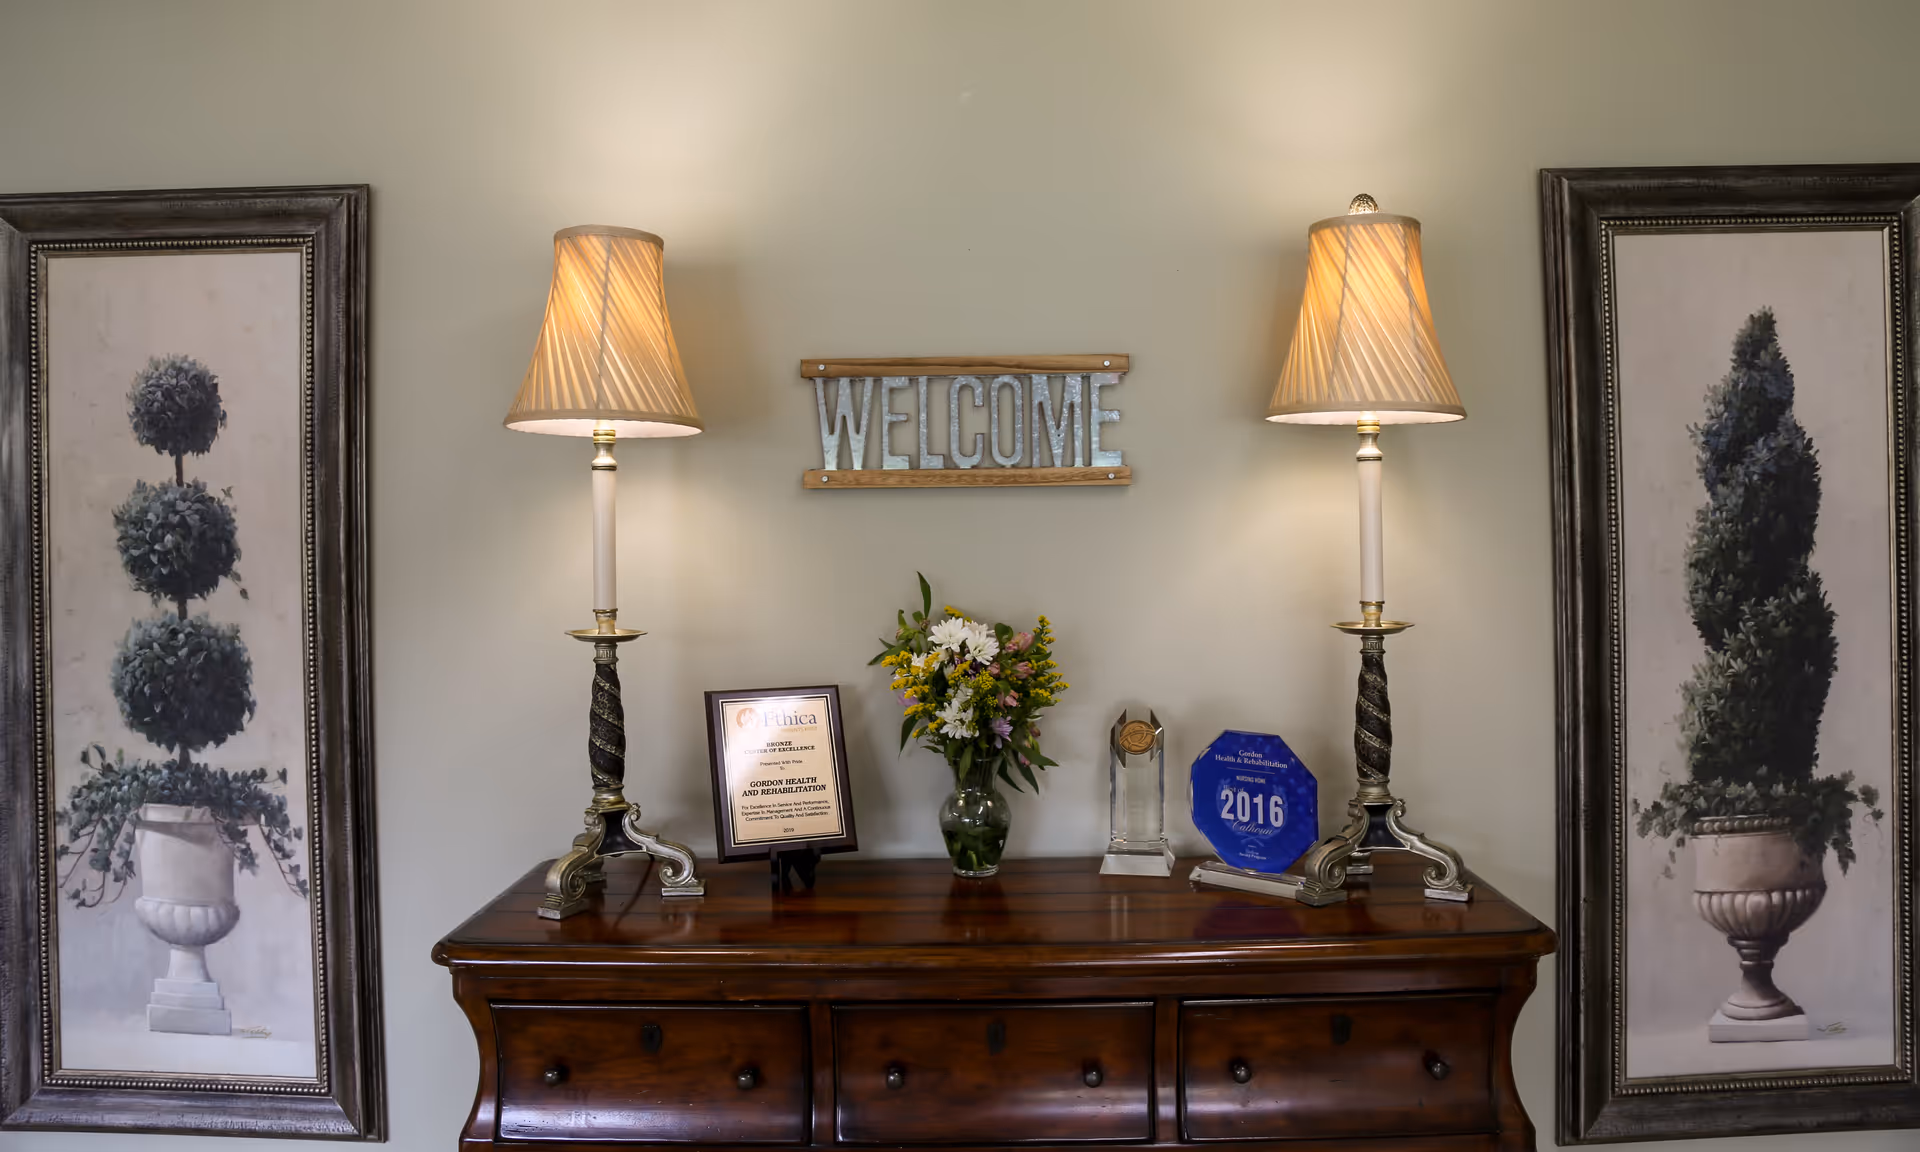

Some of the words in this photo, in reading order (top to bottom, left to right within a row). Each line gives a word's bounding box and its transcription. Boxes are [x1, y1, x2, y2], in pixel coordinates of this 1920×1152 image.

[815, 373, 1123, 470] WELCOME
[764, 709, 817, 727] Ethica
[1215, 754, 1236, 762] Health
[1244, 758, 1287, 768] Rehabilitation
[1239, 750, 1262, 758] Gordon
[786, 777, 816, 785] HEALTH
[761, 785, 826, 795] REHABILITATION
[1221, 789, 1284, 827] 2016
[1232, 820, 1273, 835] Calhoun
